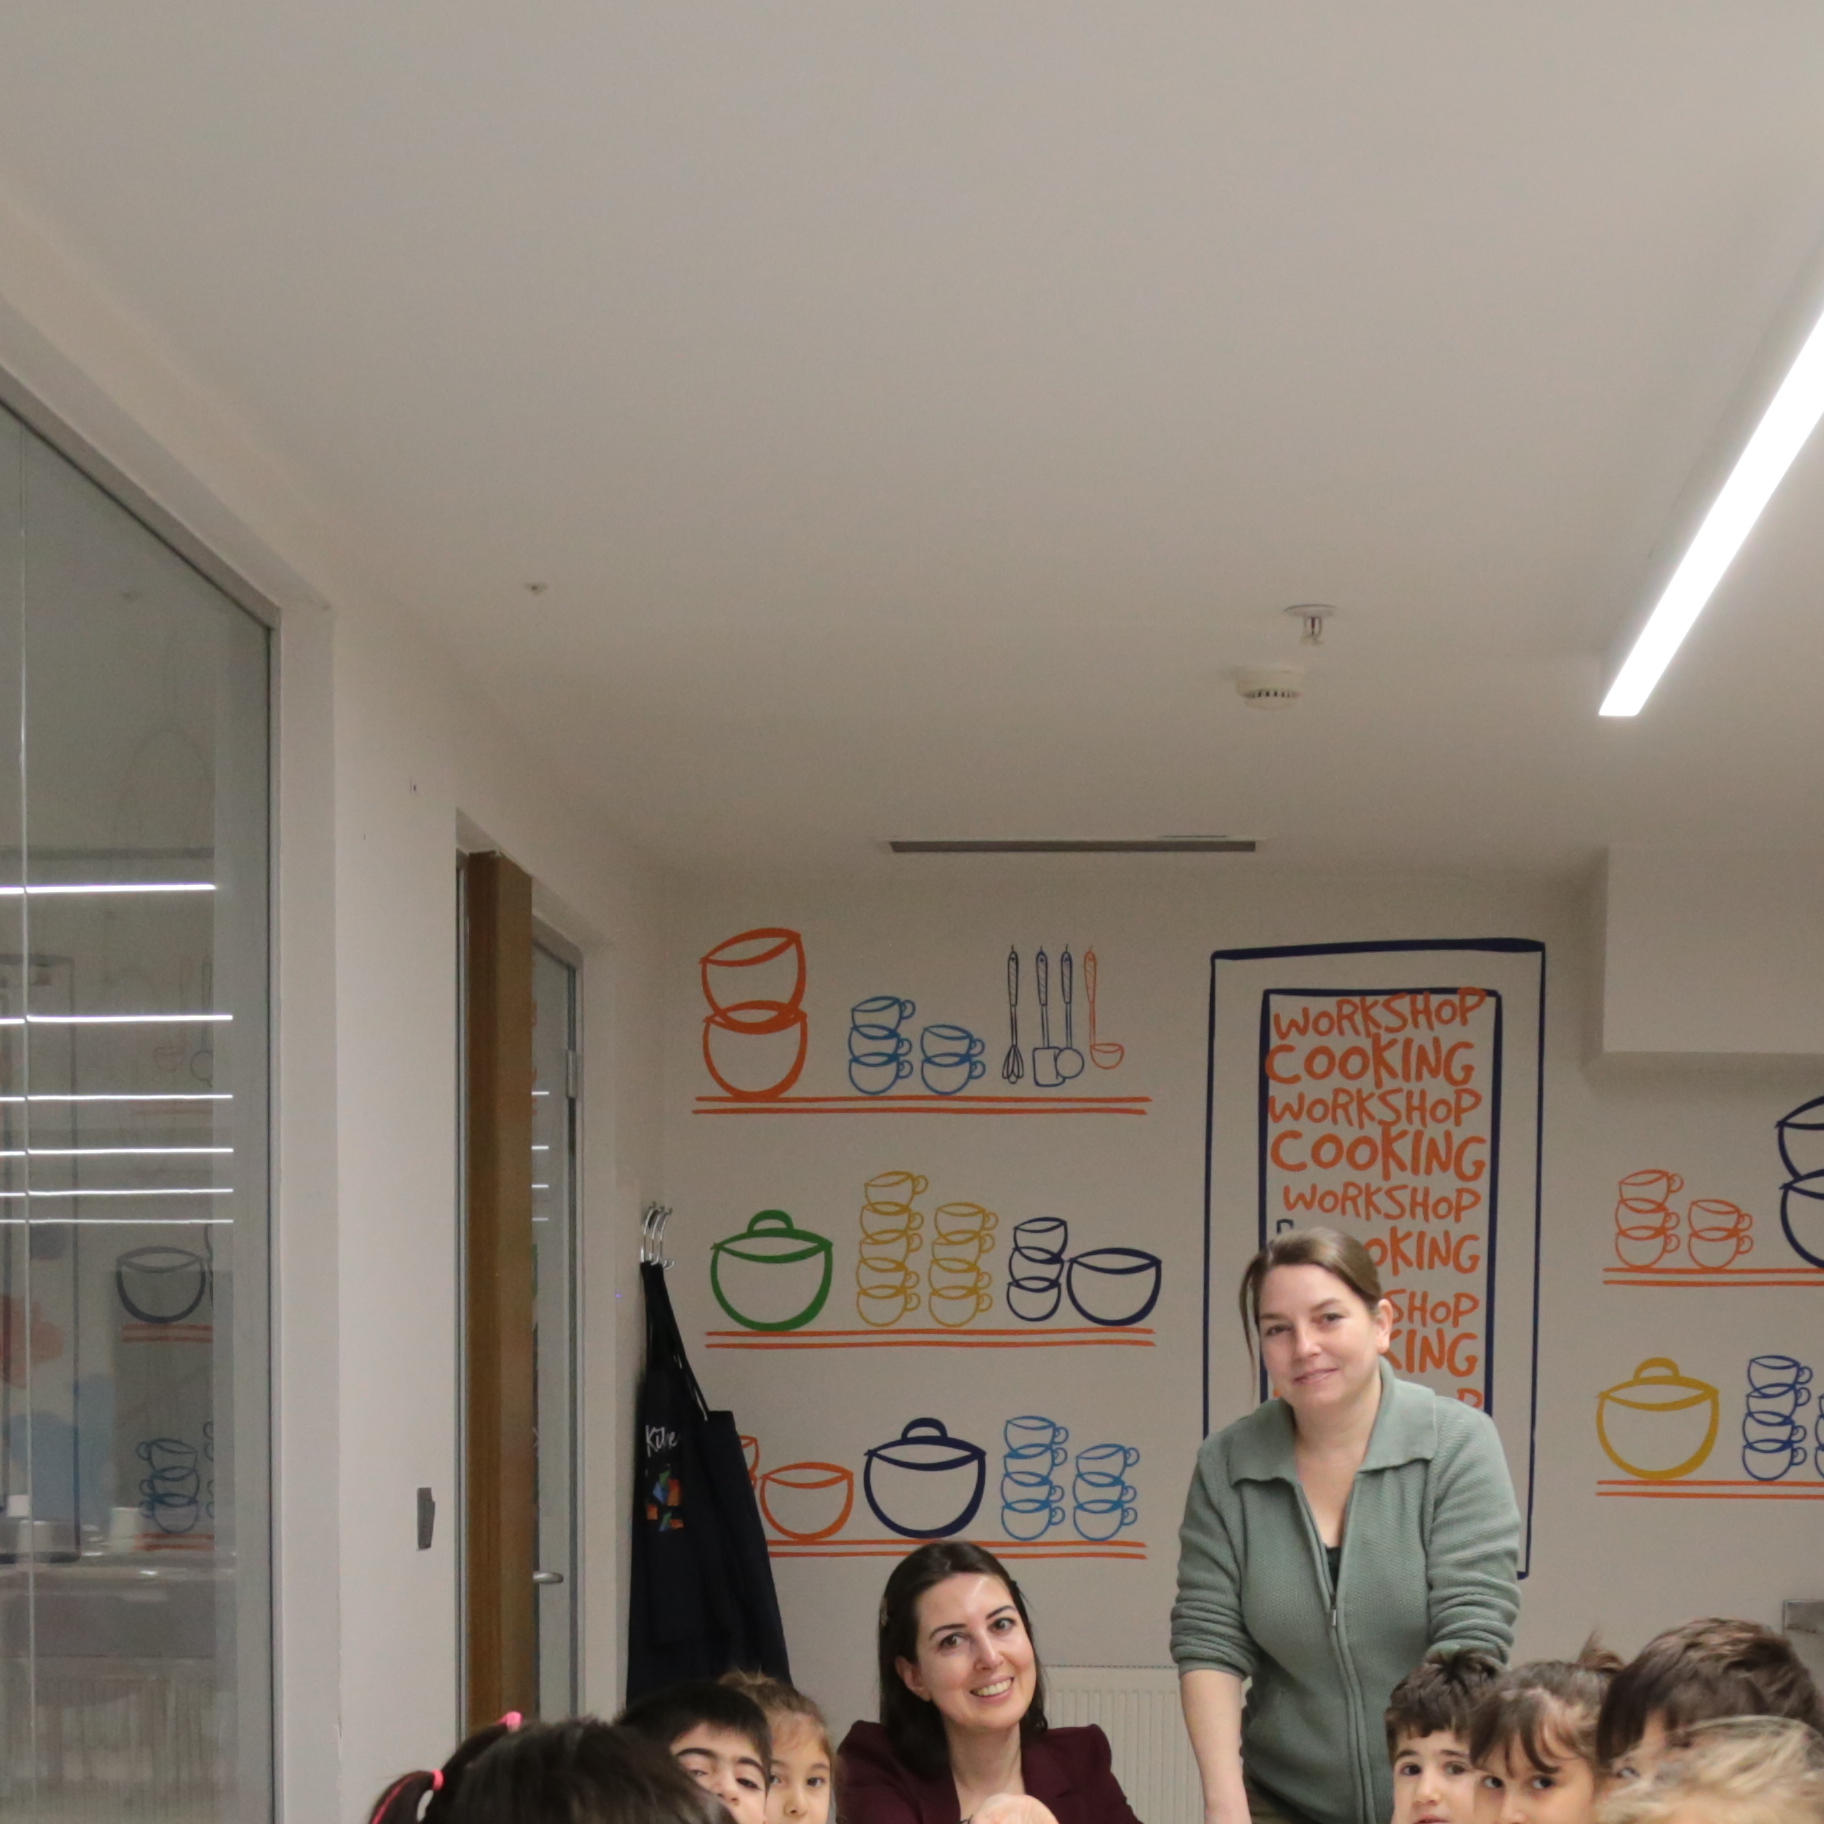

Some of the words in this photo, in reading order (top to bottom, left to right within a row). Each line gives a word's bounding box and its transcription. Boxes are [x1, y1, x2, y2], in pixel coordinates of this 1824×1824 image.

[1273, 987, 1487, 1041] WORKSHOP
[1265, 1032, 1475, 1089] COOKING
[1268, 1087, 1483, 1130] WORKSHOP
[1270, 1124, 1488, 1182] COOKING
[1283, 1181, 1482, 1224] WORKSHOP
[1363, 1226, 1481, 1276] OKING
[1383, 1288, 1480, 1328] SHOP
[1384, 1327, 1479, 1378] KING
